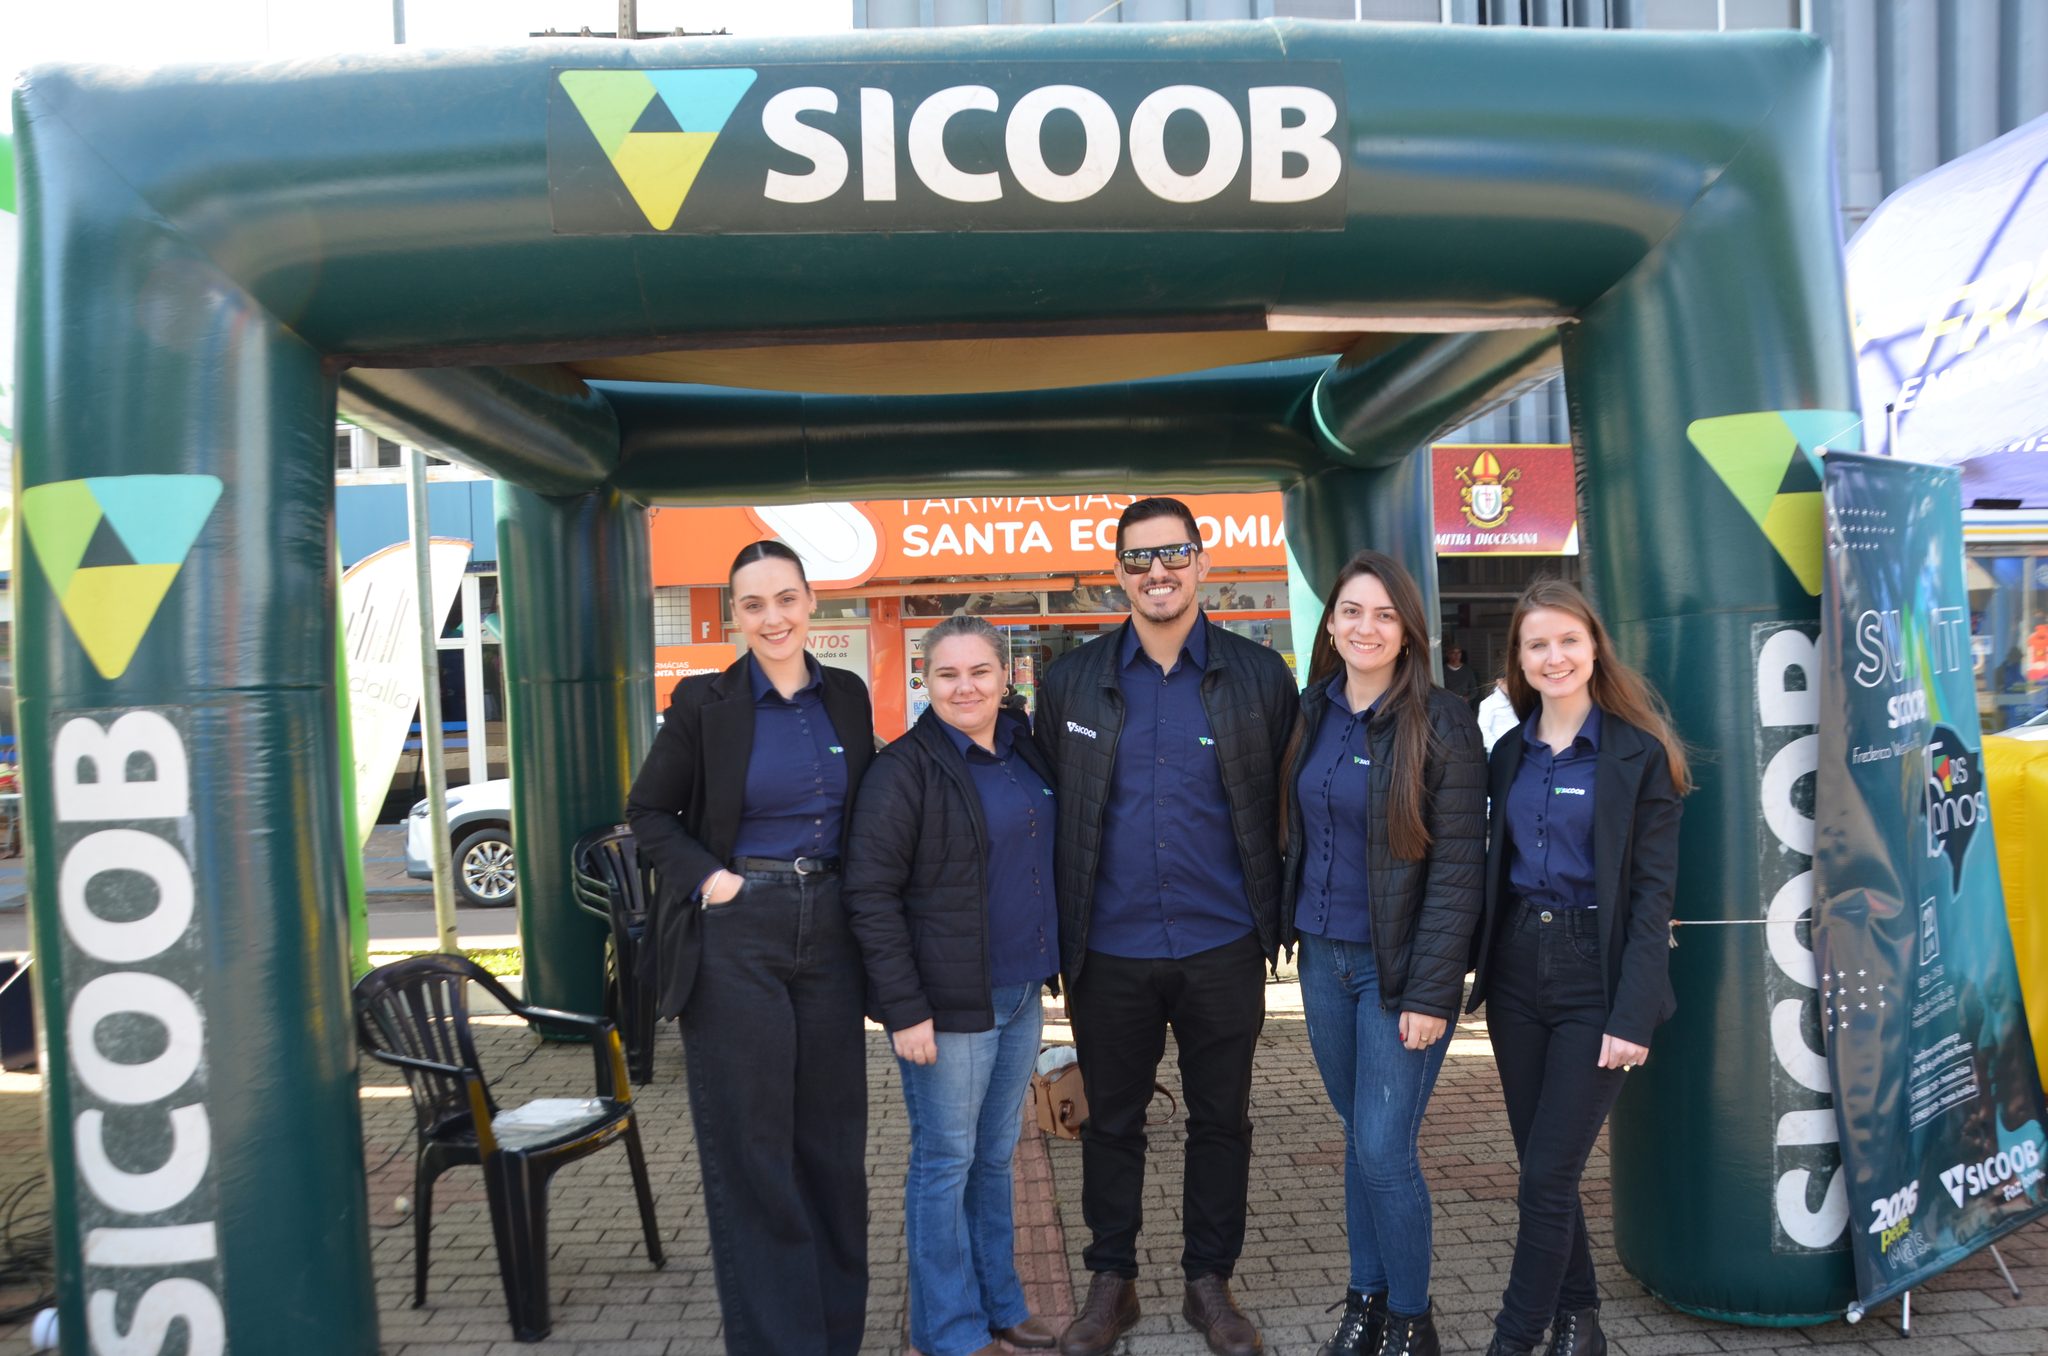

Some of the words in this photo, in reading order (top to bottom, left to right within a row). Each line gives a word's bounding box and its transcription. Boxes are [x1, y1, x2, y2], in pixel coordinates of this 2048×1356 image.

[761, 84, 1342, 203] SICOOB
[903, 520, 1053, 557] SANTA
[1434, 533, 1471, 545] MITRA
[1474, 532, 1538, 545] DIOCESANA
[1073, 724, 1097, 739] SICOOB
[1965, 1139, 2040, 1196] SICOOB
[1868, 1179, 1919, 1235] 2026
